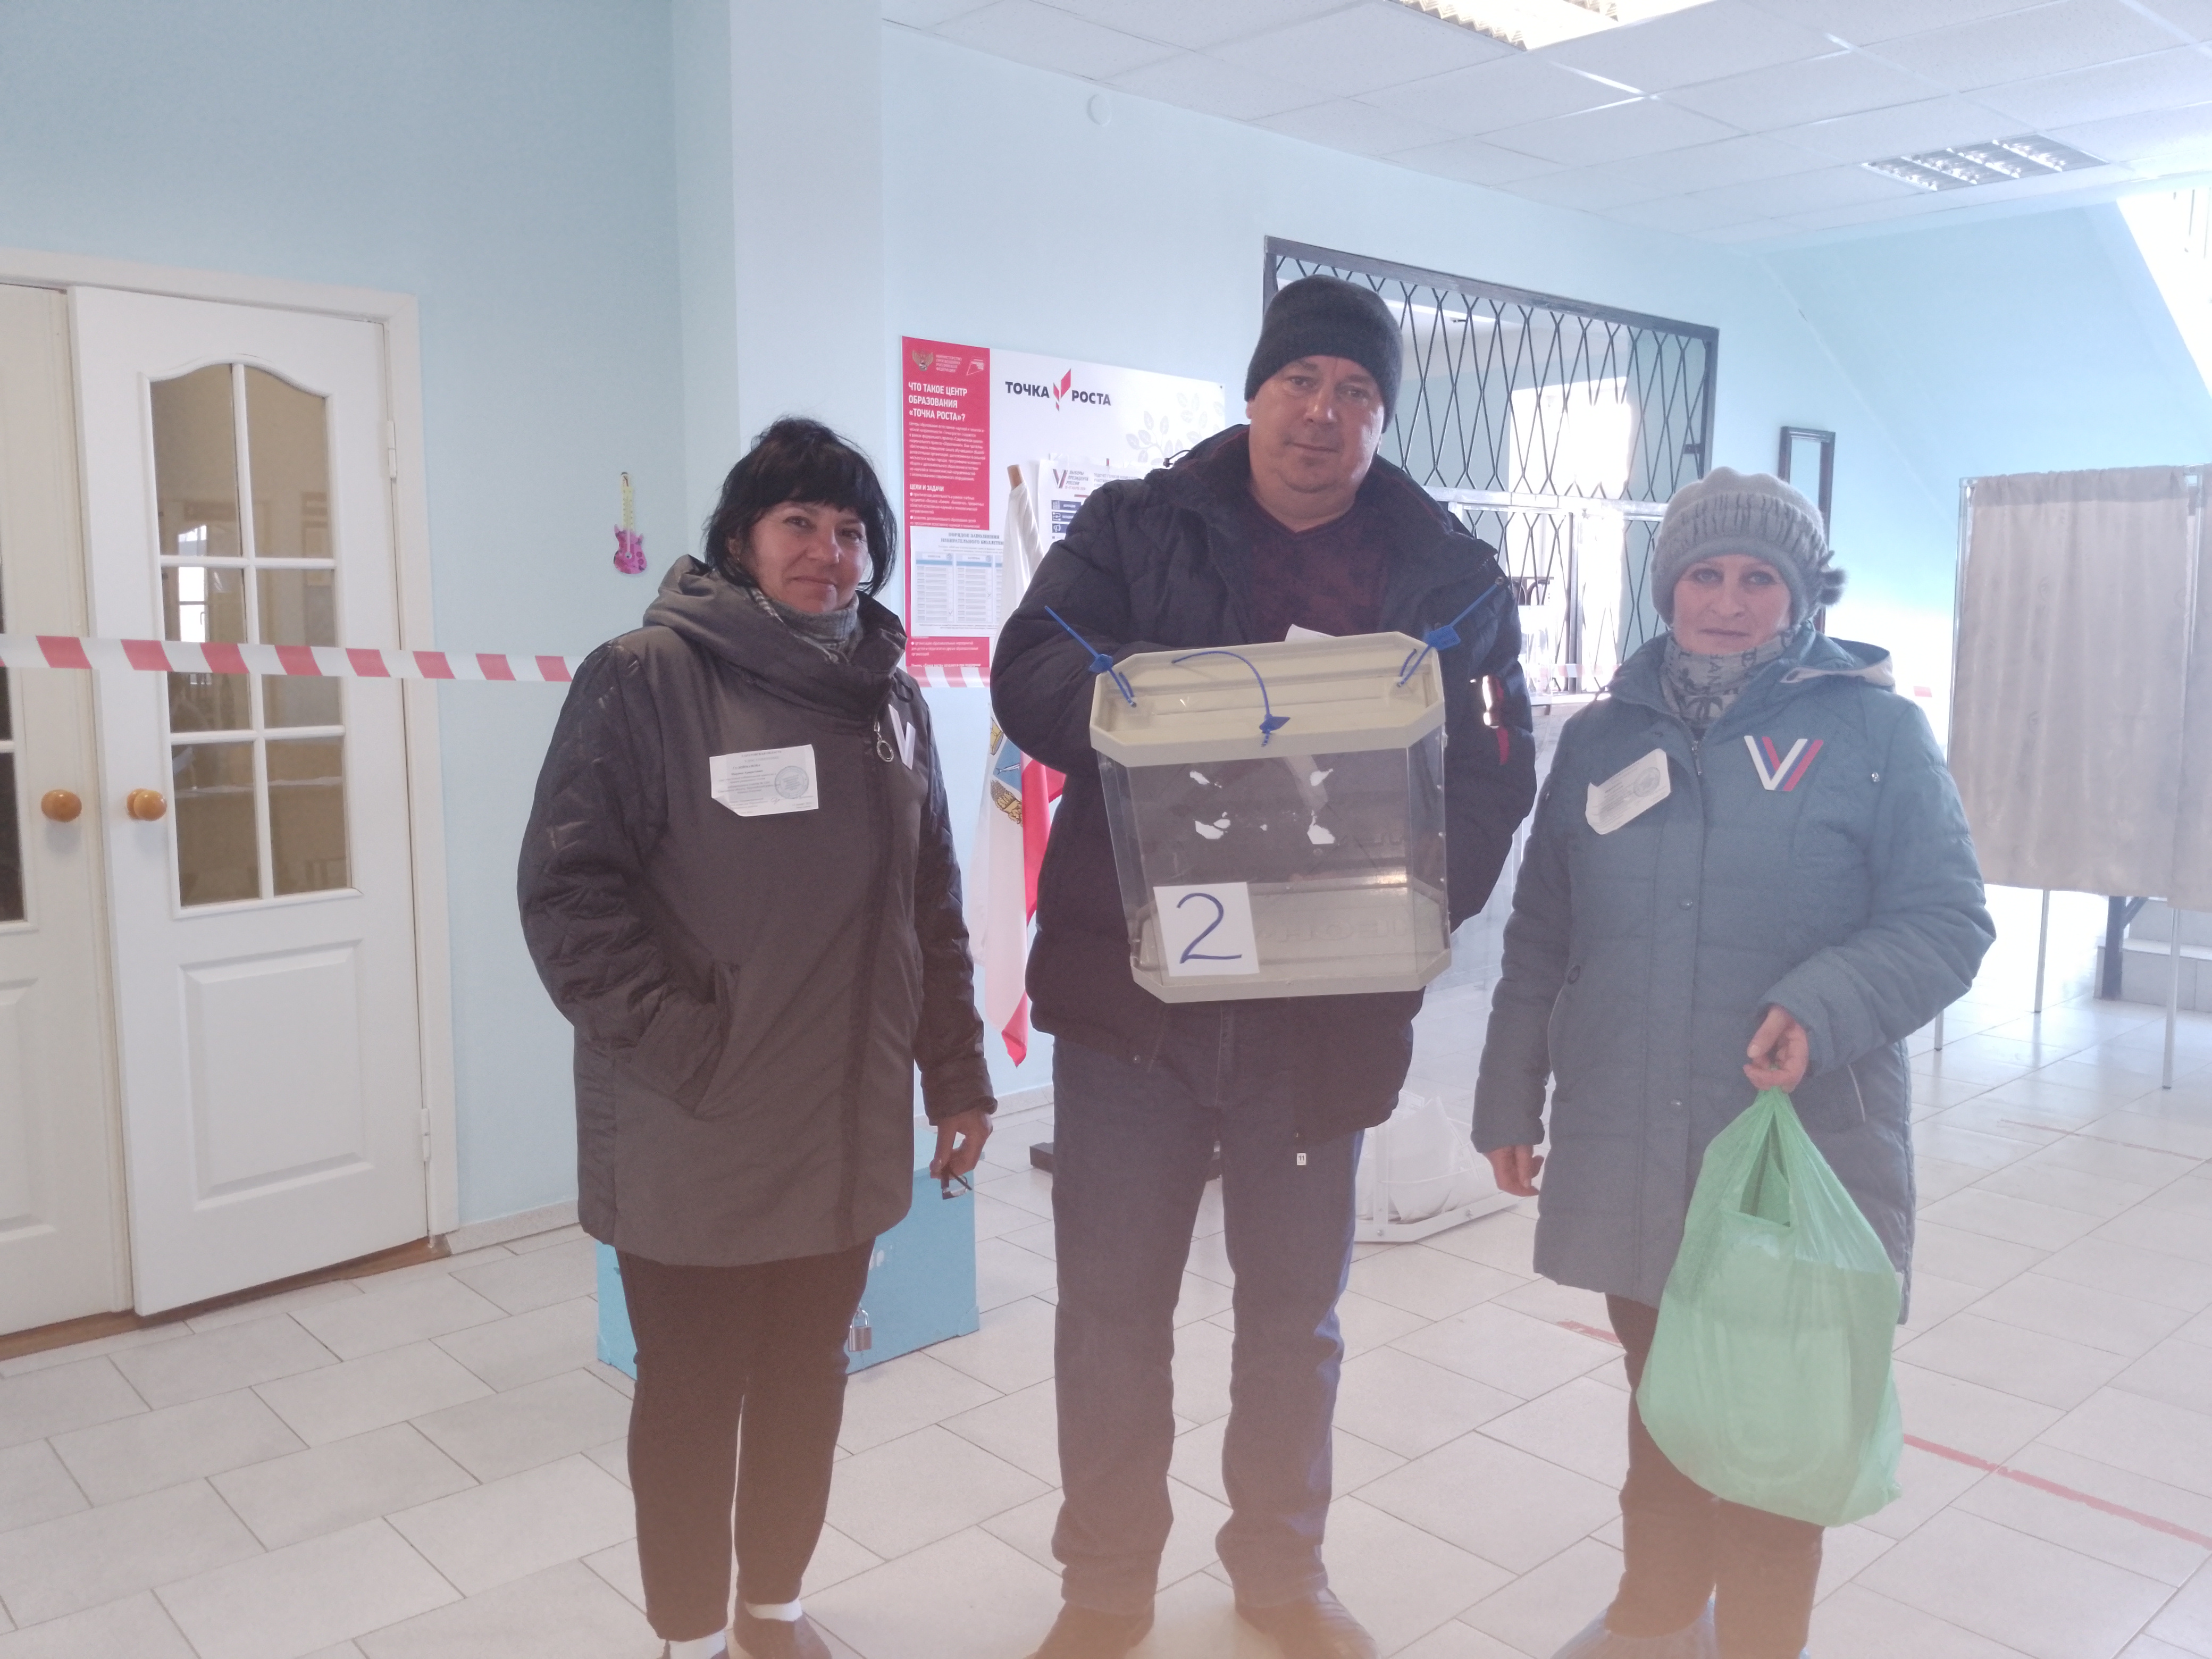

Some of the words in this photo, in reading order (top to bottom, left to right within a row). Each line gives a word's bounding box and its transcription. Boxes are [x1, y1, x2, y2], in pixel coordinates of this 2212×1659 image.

[908, 382, 921, 391] ЧТО
[924, 384, 944, 394] ТАКОЕ
[946, 387, 967, 397] ЦЕНТР
[1005, 381, 1050, 398] ТОЧКА
[1071, 390, 1111, 406] РОСТА
[908, 395, 958, 408] ОБРАЗОВАНИЯ
[909, 408, 935, 419] «ТОЧКА
[937, 411, 965, 422] РОСТА»?
[1176, 893, 1242, 964] 2
